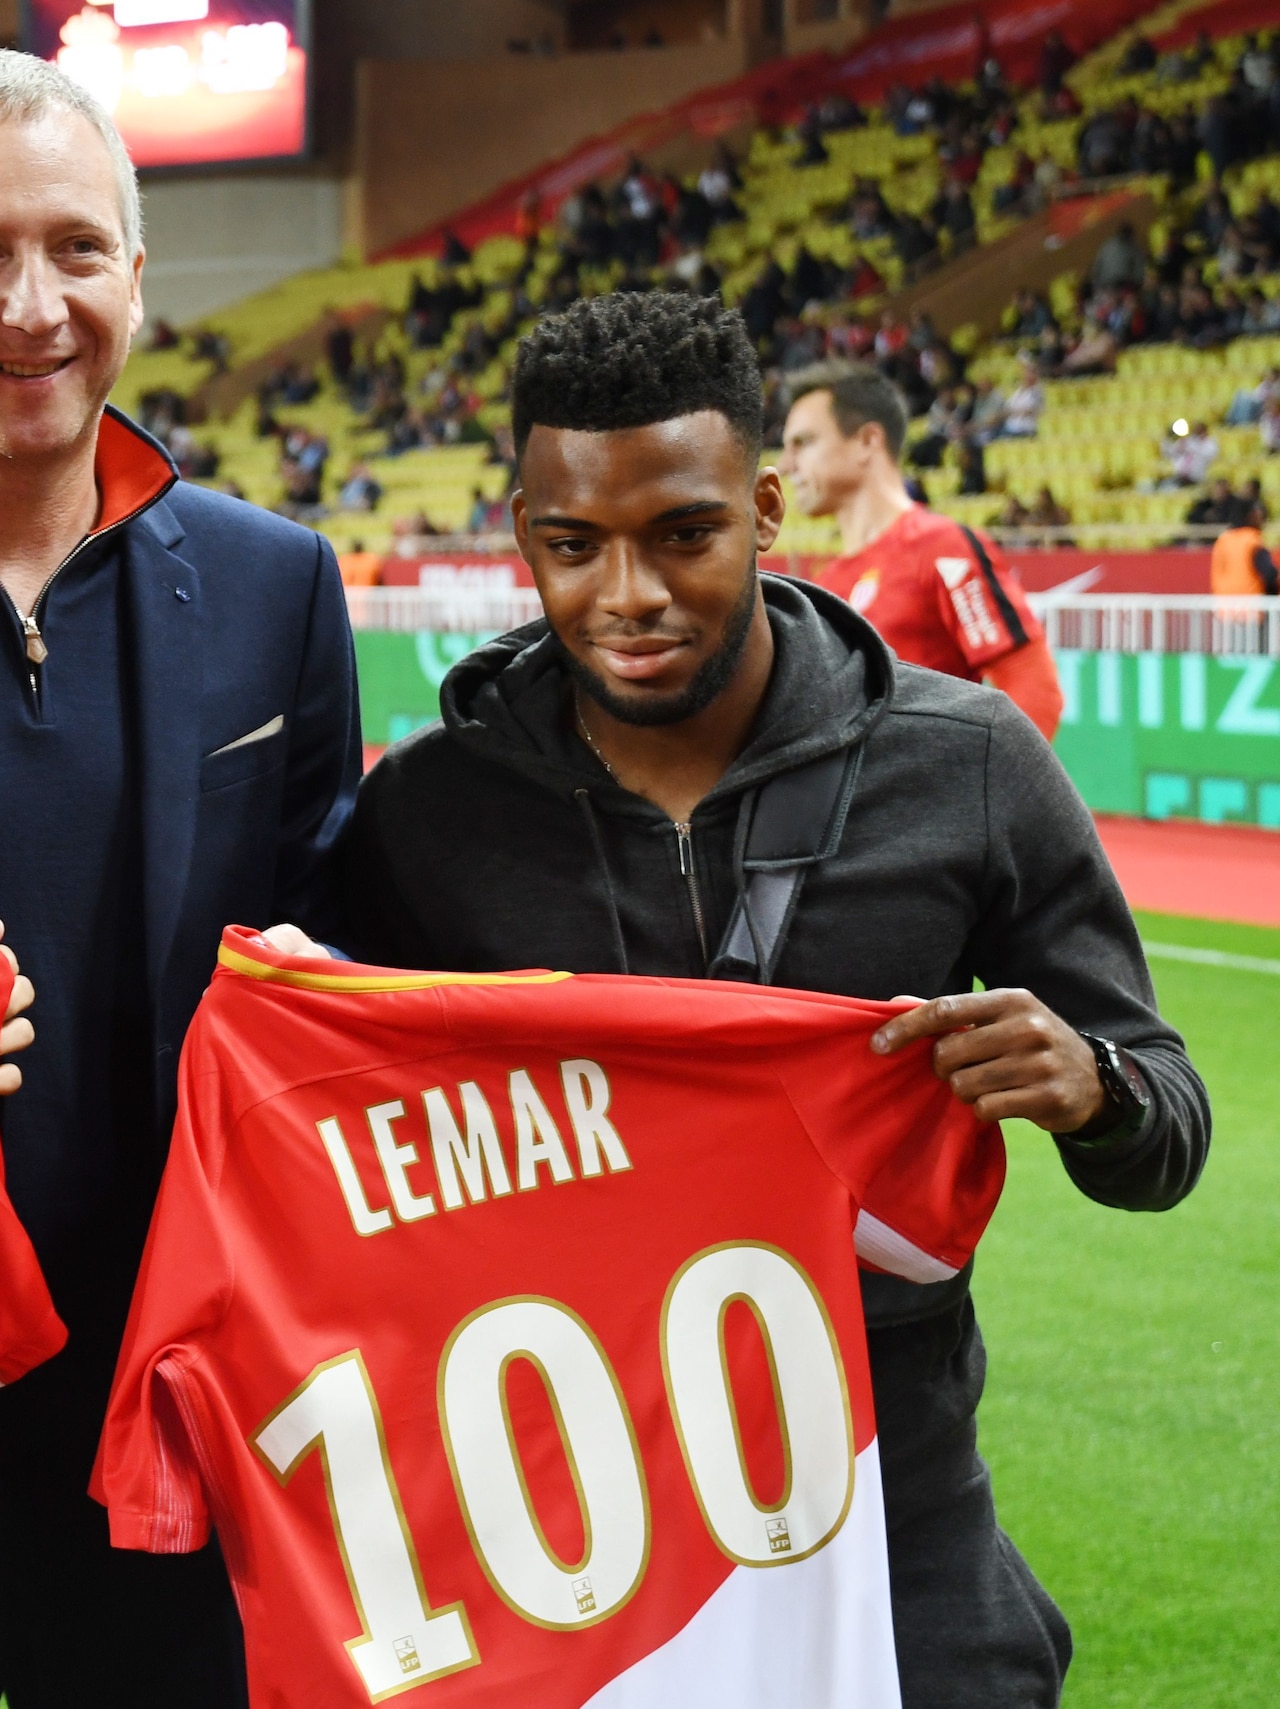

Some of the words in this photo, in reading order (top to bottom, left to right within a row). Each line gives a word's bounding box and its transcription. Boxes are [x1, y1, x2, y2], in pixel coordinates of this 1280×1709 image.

[316, 1057, 633, 1237] LEMAR
[247, 1239, 856, 1706] 100
[770, 1539, 789, 1550] LFP
[578, 1598, 594, 1611] LFP
